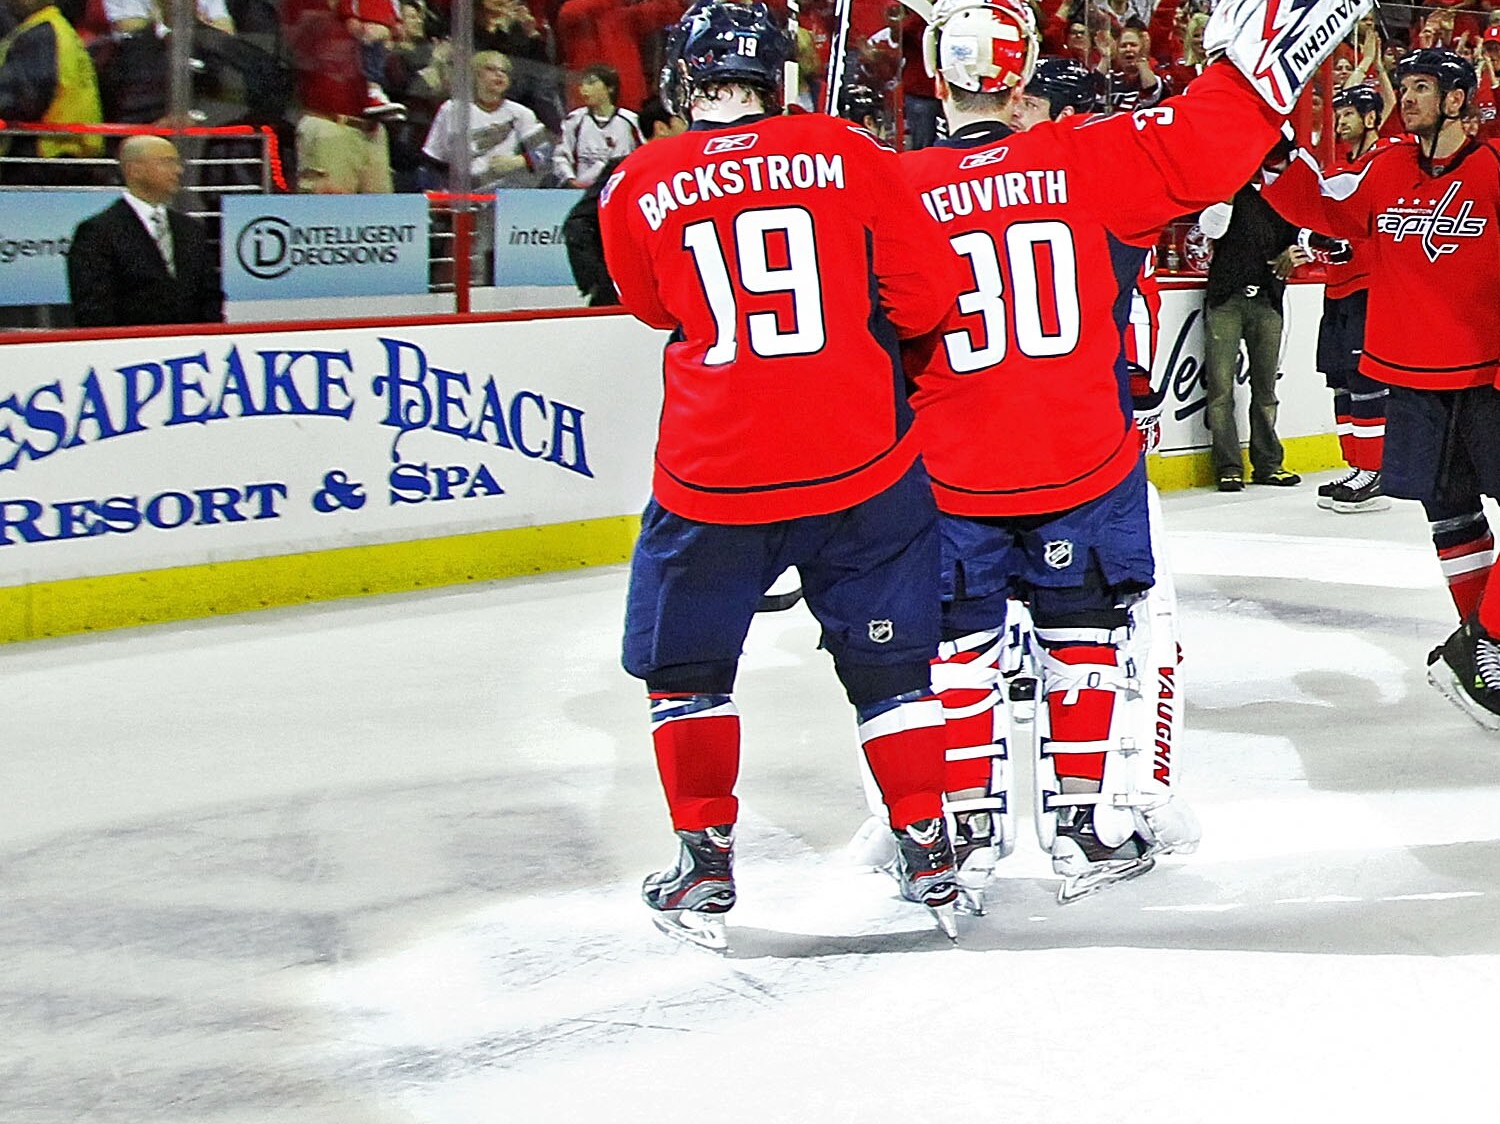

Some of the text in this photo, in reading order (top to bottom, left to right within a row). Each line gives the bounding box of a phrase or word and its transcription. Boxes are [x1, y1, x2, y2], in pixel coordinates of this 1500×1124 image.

[737, 36, 757, 57] 19
[638, 153, 844, 231] BACKSTROM
[1377, 181, 1487, 263] capitals
[291, 225, 416, 244] INTELLIGENT
[291, 245, 398, 267] DECISIONS
[508, 227, 566, 245] intell
[683, 205, 826, 367] 19
[944, 220, 1080, 374] 30
[373, 337, 595, 478] BEACH
[0, 463, 505, 545] RESORT & SPA
[1153, 666, 1176, 787] VAUGHN
